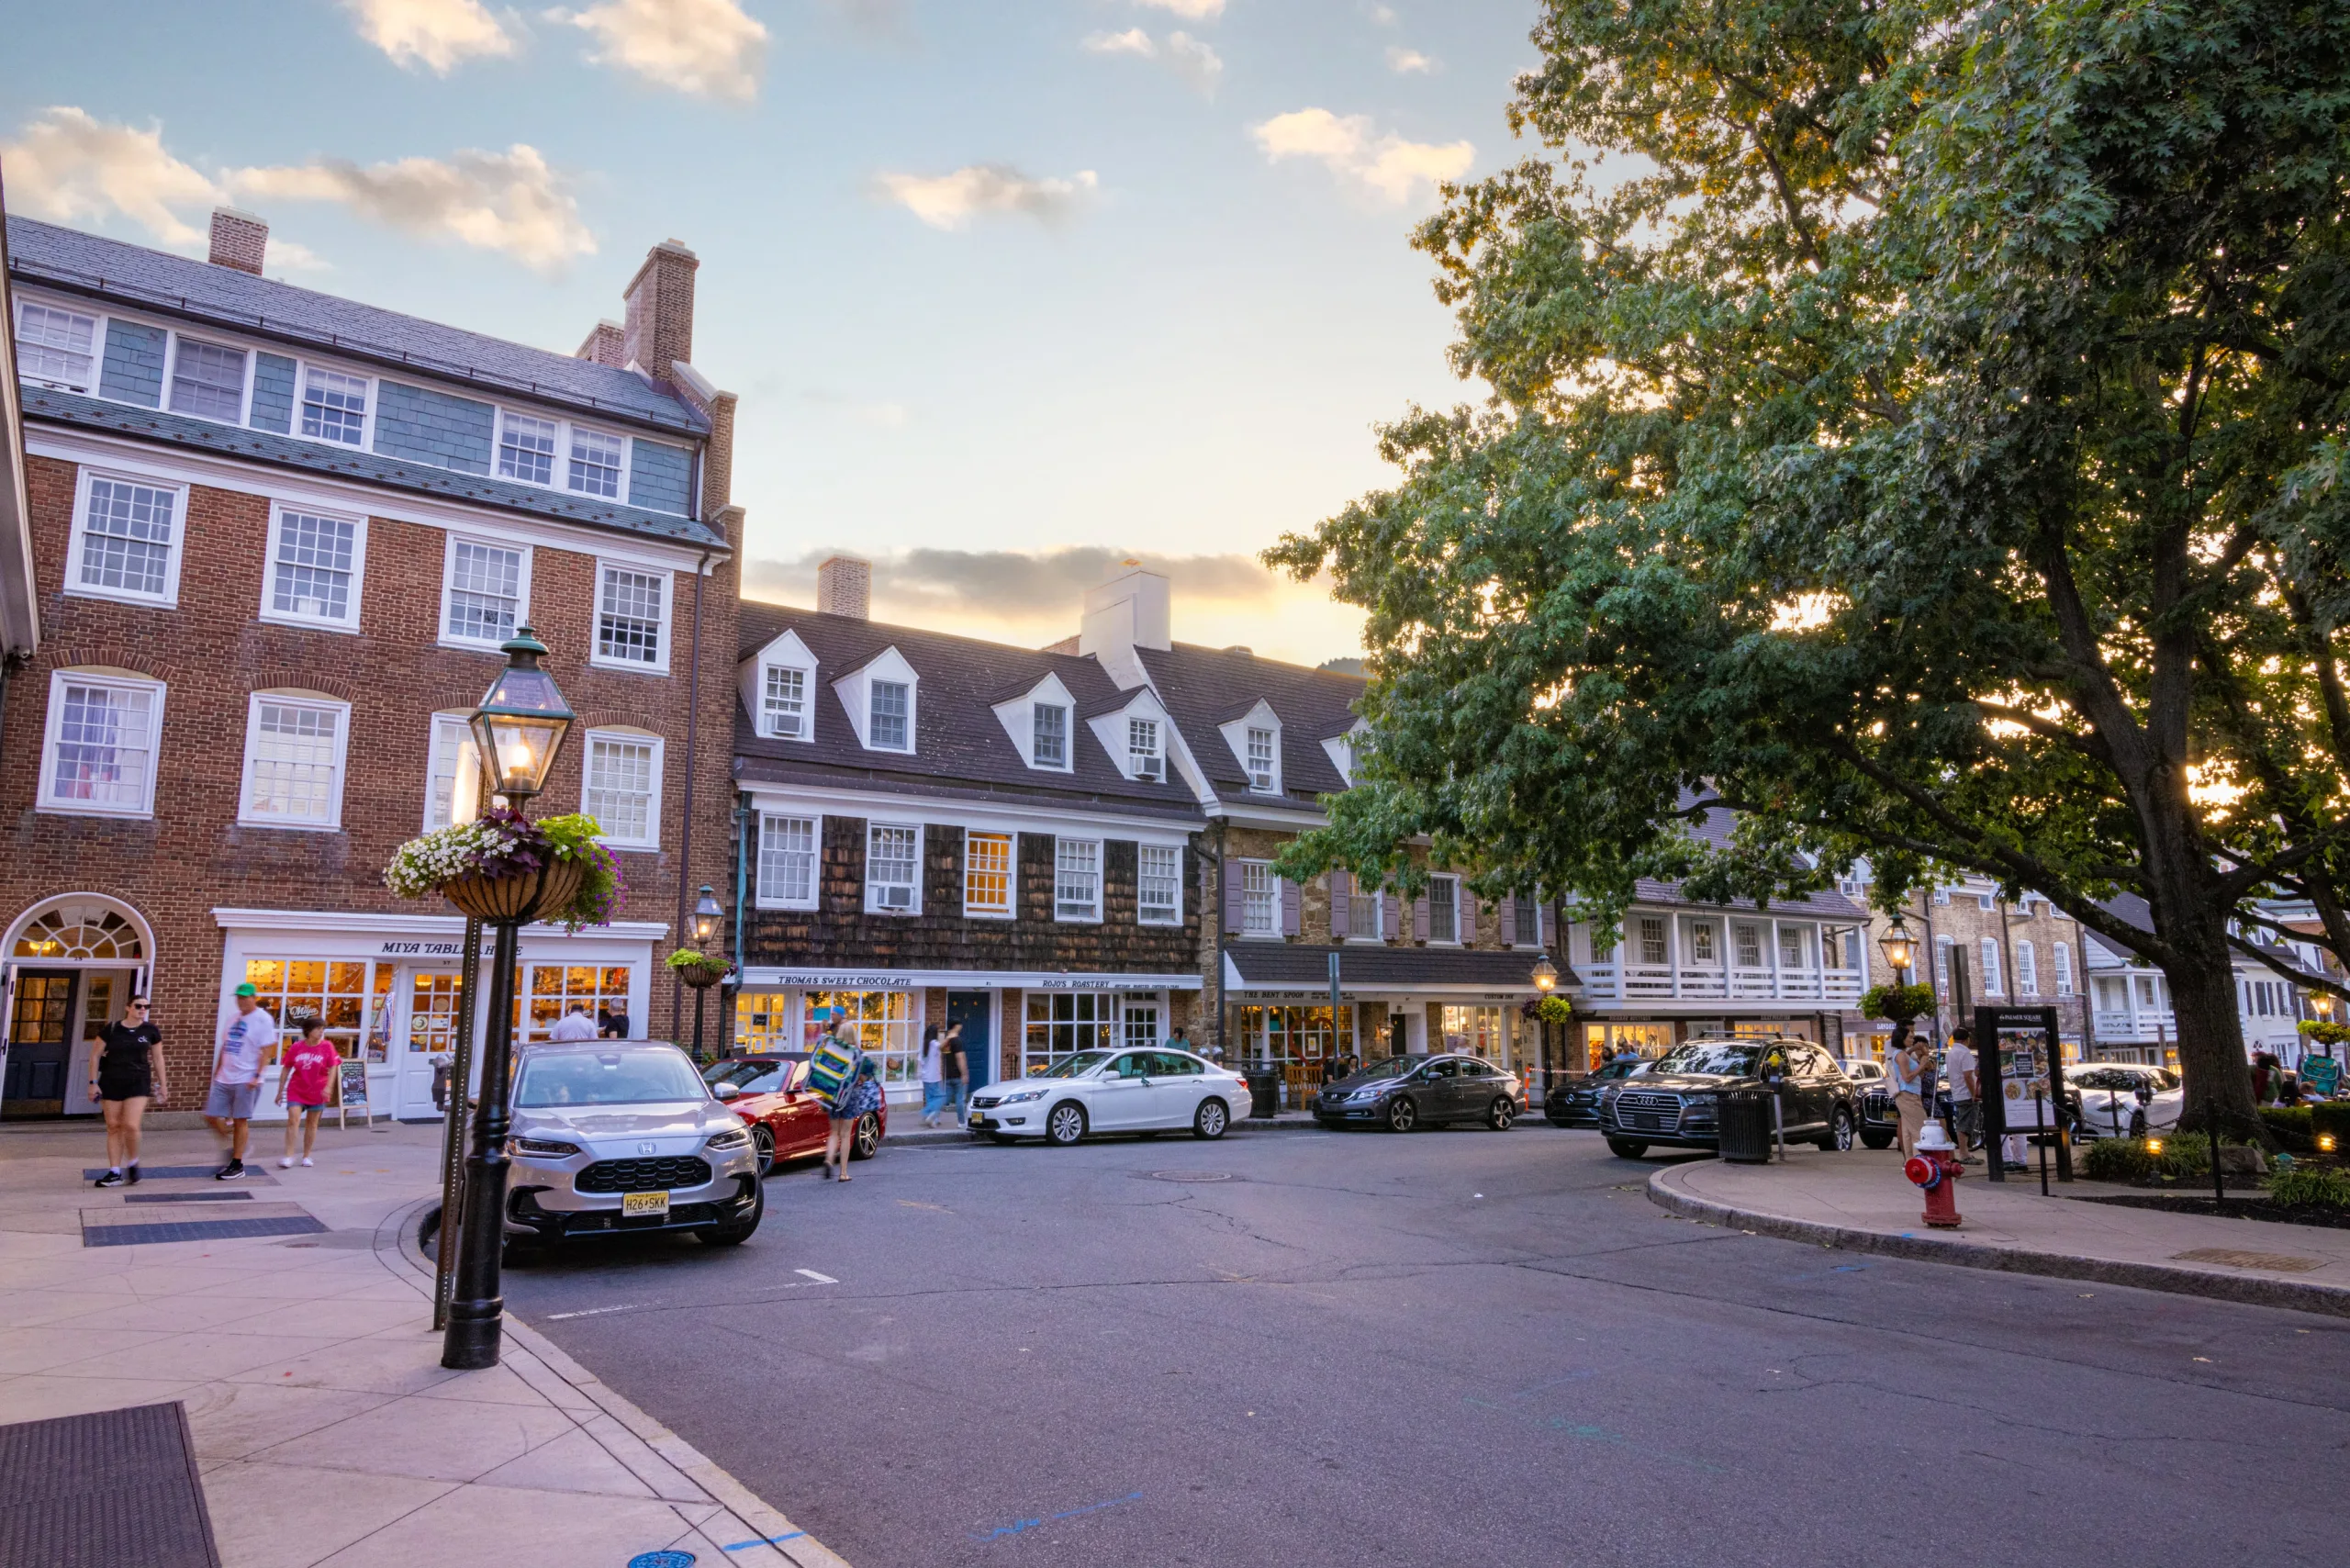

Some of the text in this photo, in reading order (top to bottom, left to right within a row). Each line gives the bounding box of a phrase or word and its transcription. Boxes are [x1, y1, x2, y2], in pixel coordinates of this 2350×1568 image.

[382, 942, 420, 953] MIYA
[484, 945, 523, 956] HE
[778, 976, 912, 986] THOMAS SWEET CHOCOLATE
[1043, 980, 1067, 988] ROJO'S
[289, 1004, 319, 1019] Miya
